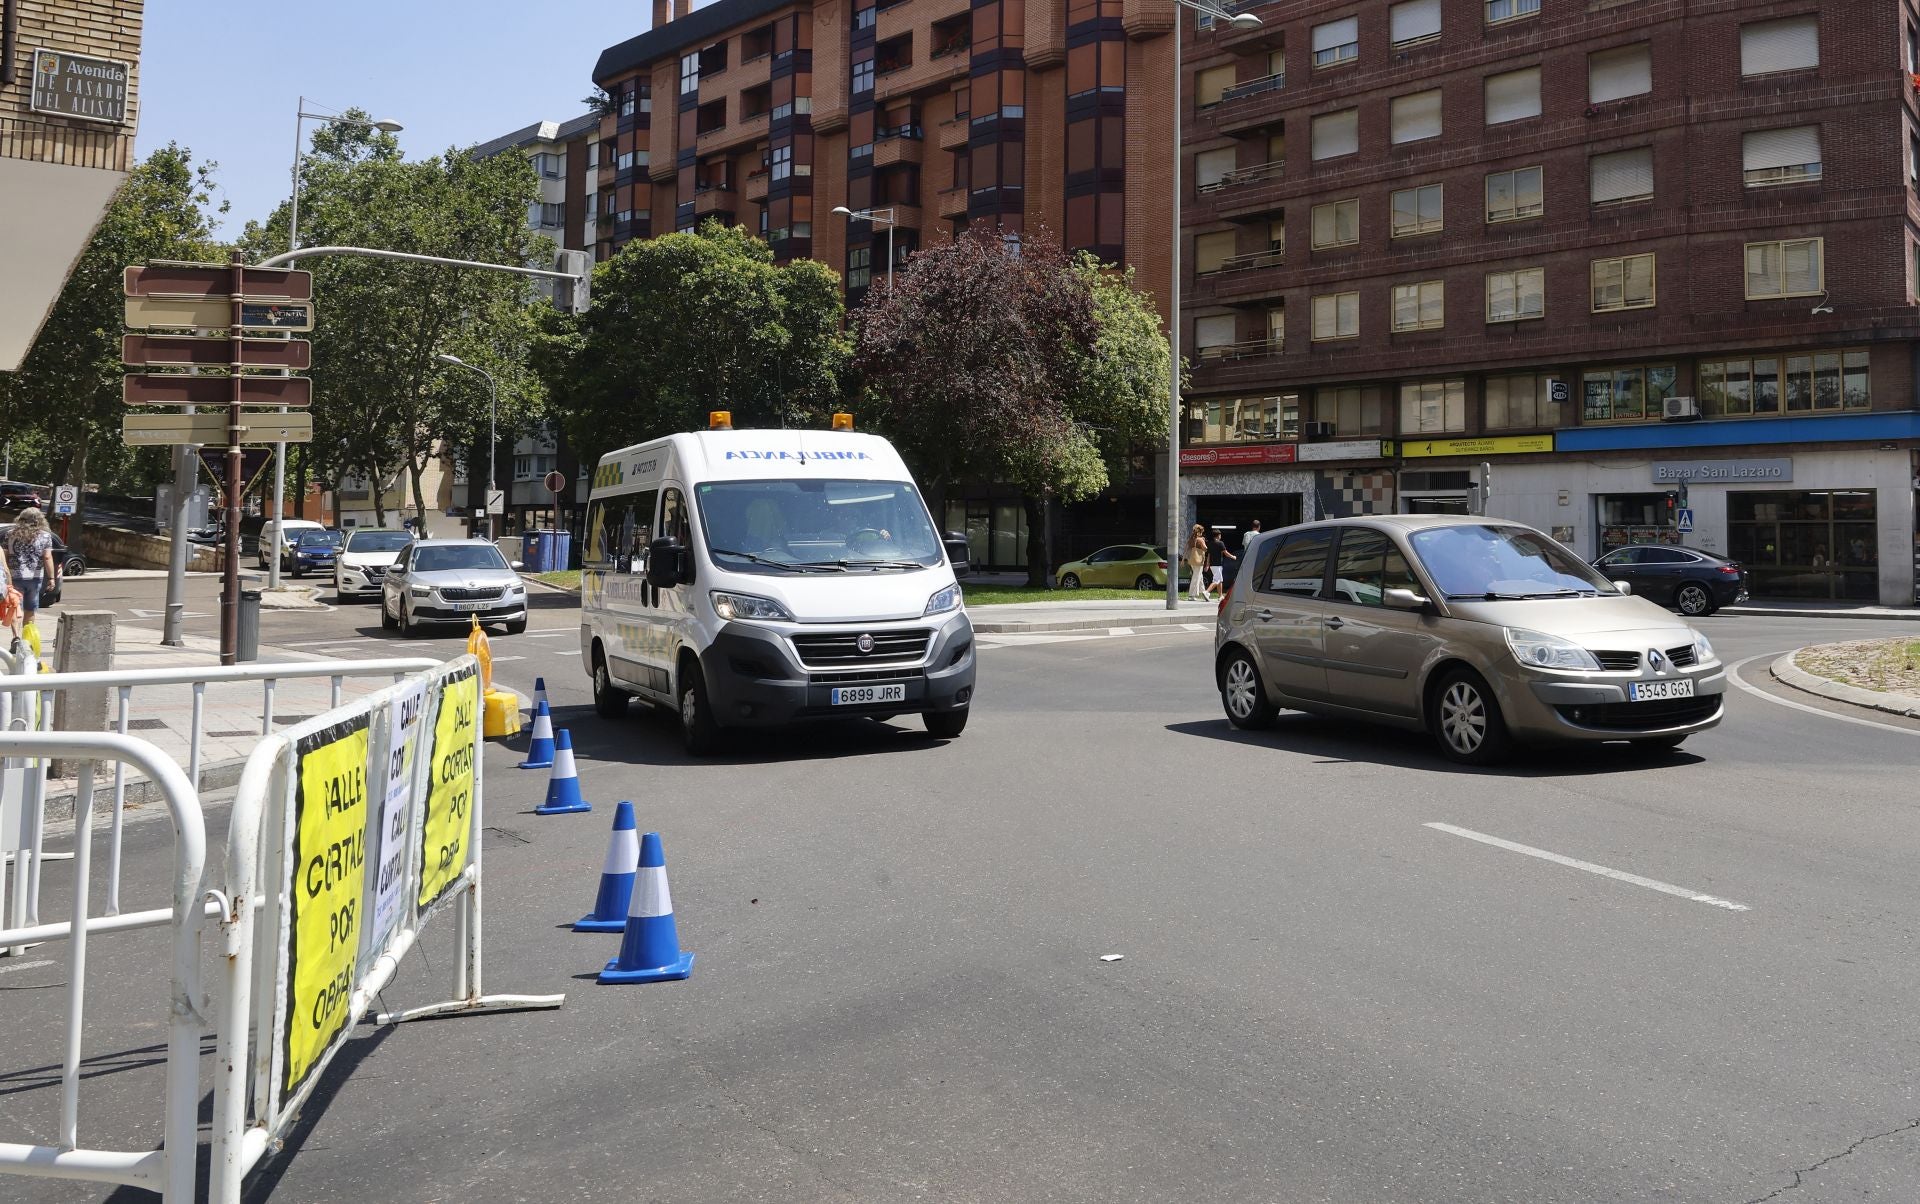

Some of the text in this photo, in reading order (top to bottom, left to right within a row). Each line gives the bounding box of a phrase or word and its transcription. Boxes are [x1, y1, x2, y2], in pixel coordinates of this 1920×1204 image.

[66, 60, 124, 81] Avenida
[38, 73, 123, 100] DE CASADO
[35, 91, 122, 118] DEL ALISAL
[1660, 465, 1781, 478] Bazar San Lazaro
[841, 686, 901, 702] 6899 JRR
[1637, 680, 1692, 699] 5548 GGX
